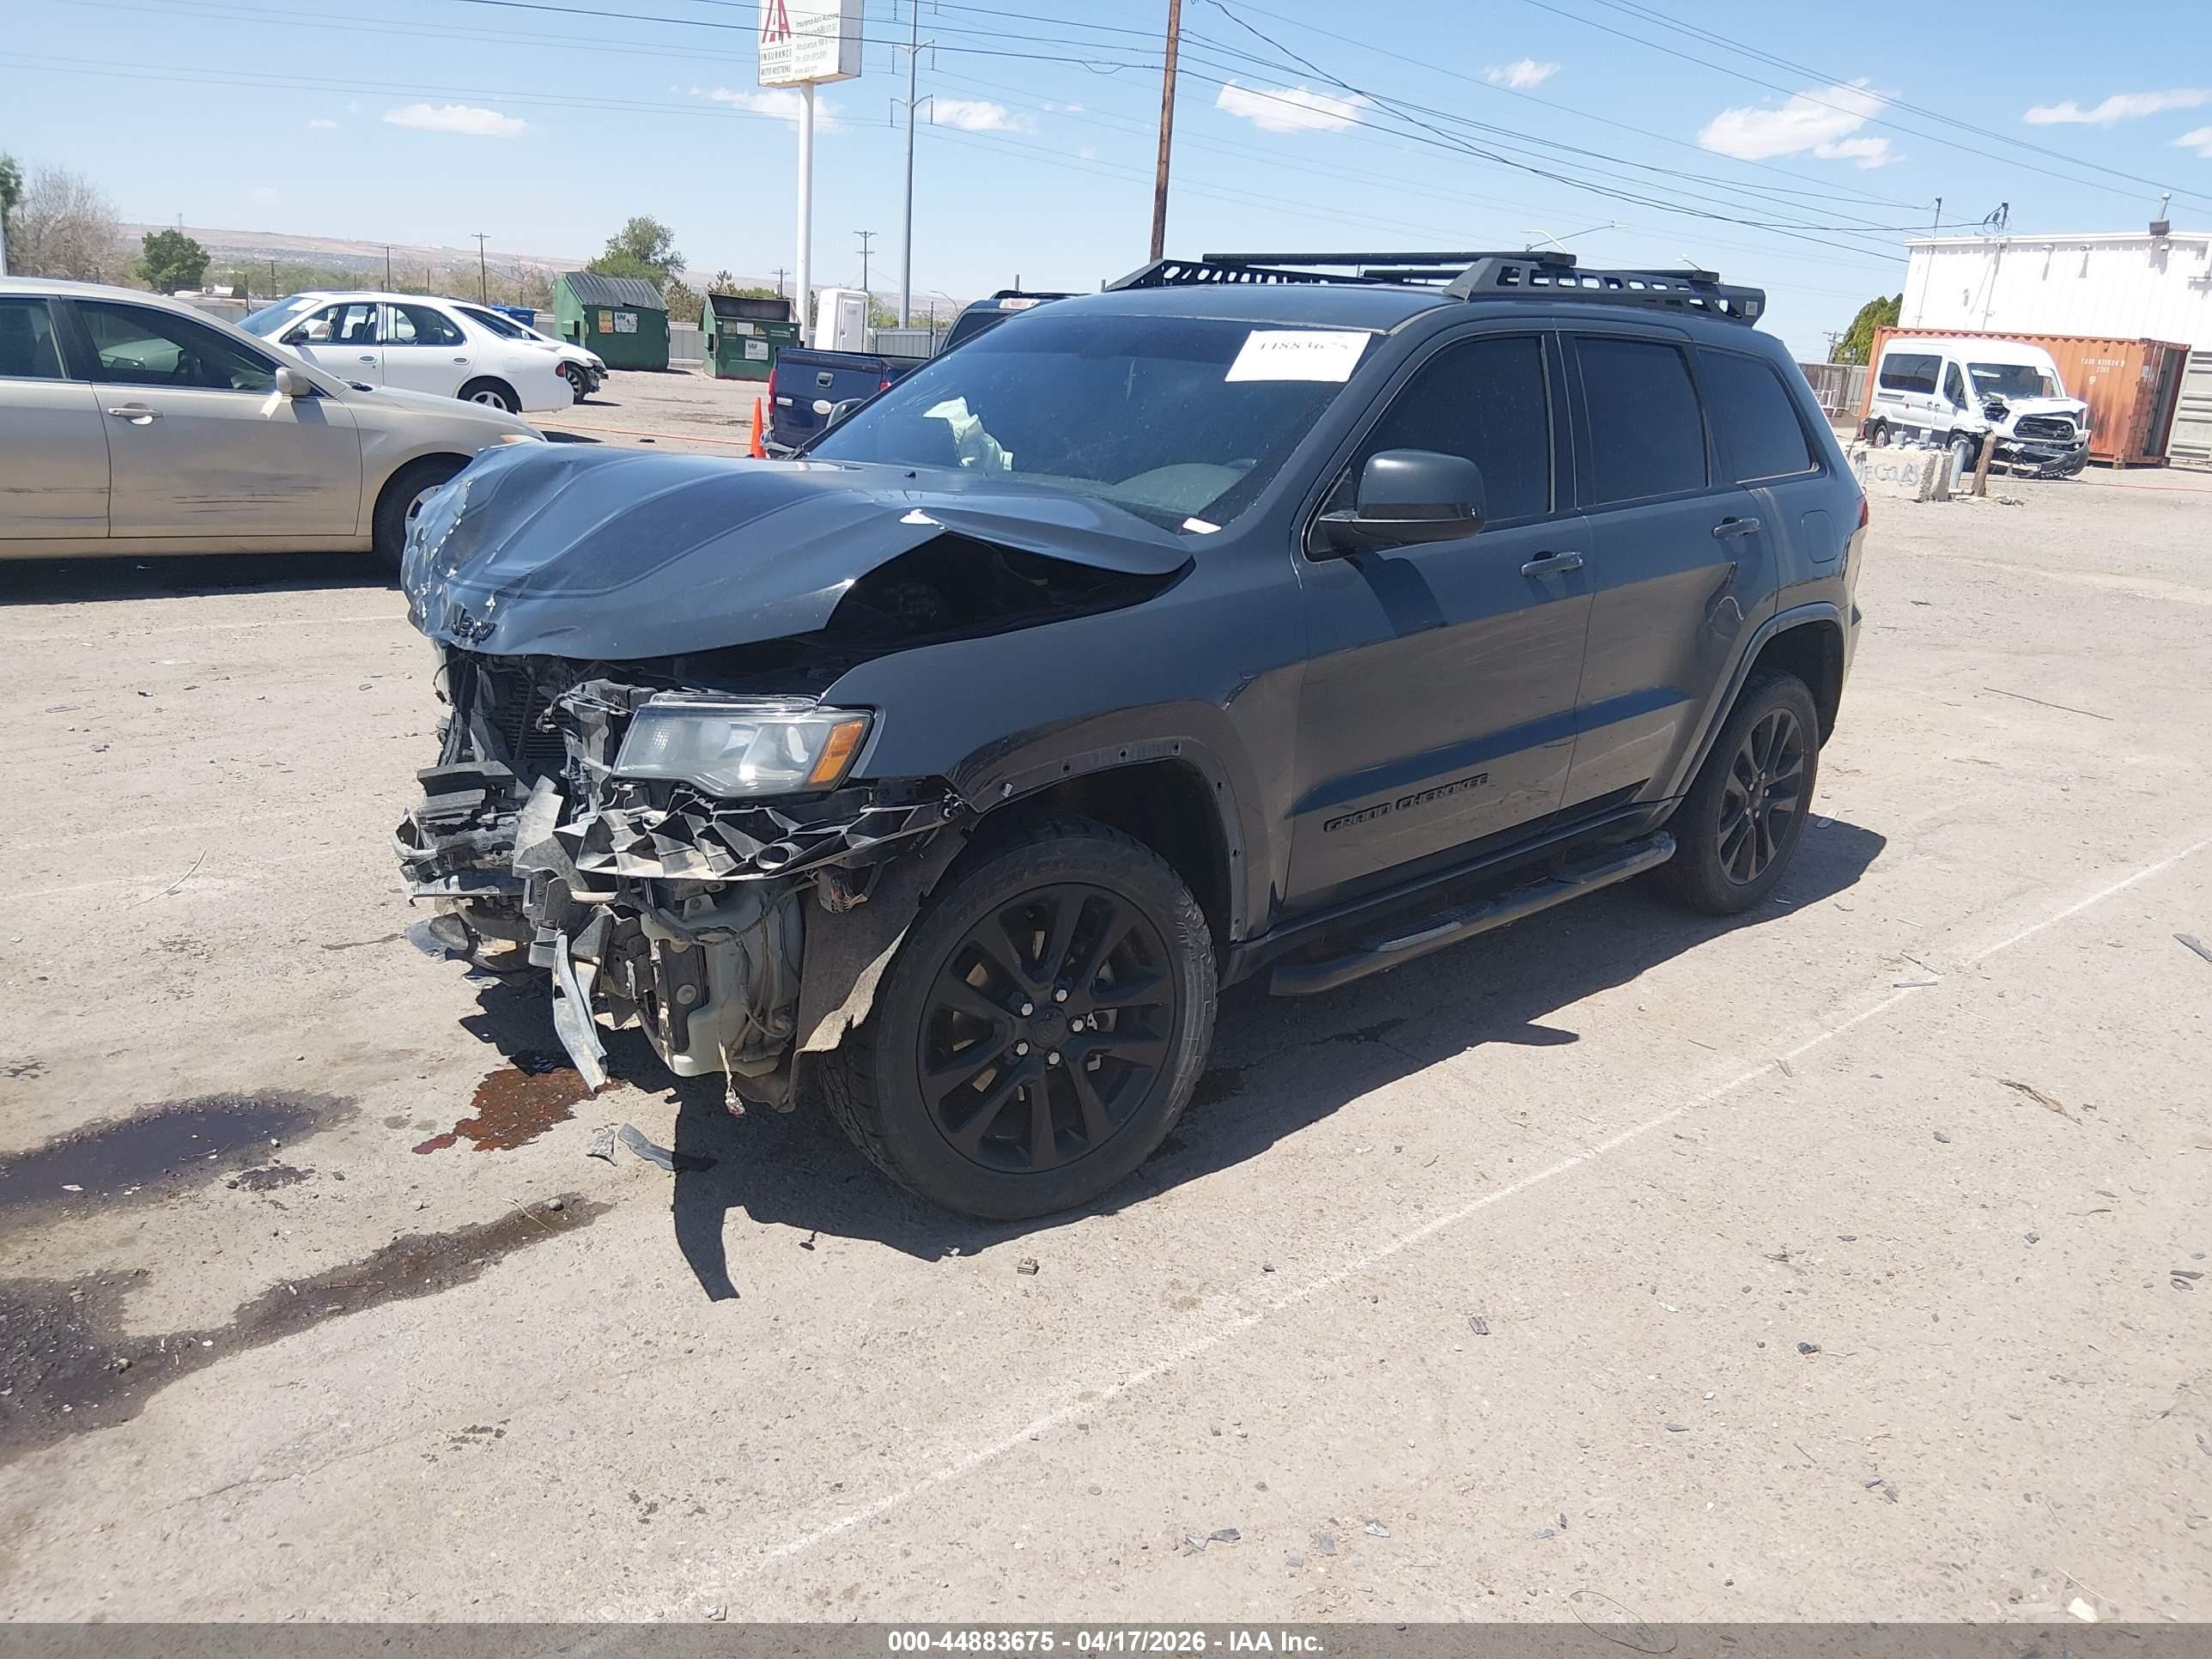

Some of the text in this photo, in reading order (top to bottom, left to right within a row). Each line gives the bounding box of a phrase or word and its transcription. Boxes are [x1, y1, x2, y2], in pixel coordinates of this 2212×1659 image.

[761, 48, 792, 61] INSURANCE
[1323, 773, 1490, 832] GRAND CHEROKEE
